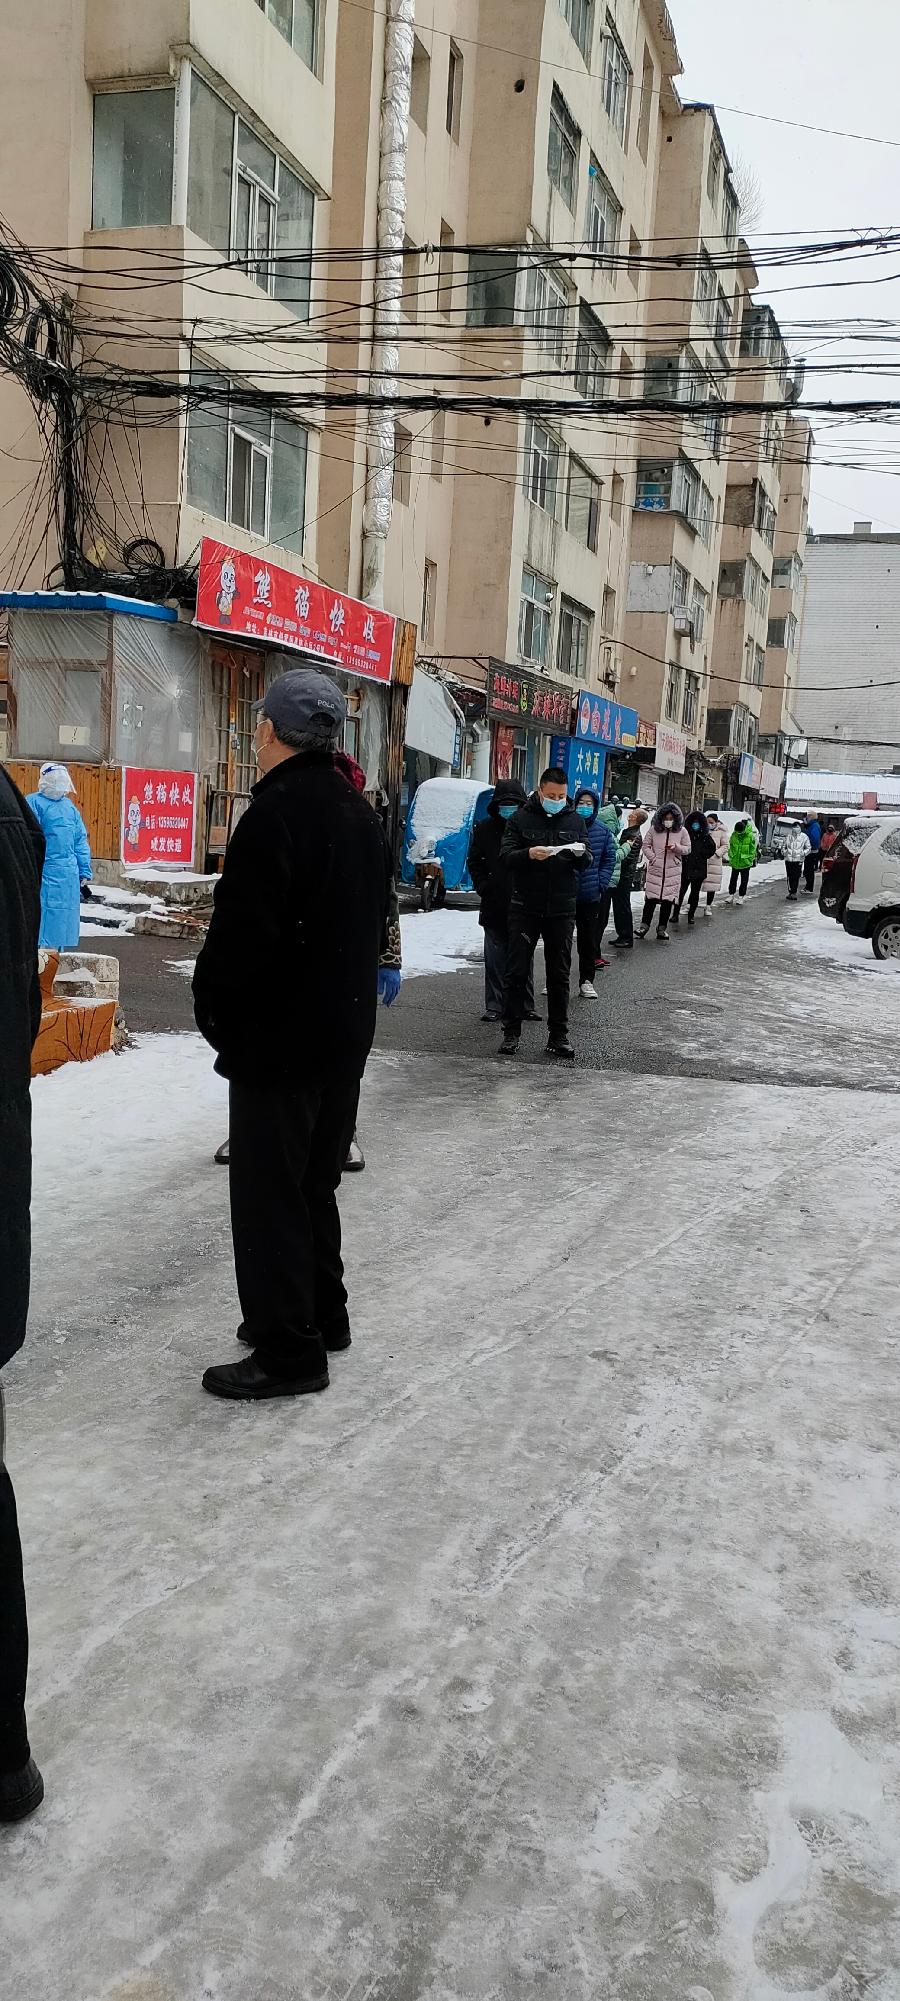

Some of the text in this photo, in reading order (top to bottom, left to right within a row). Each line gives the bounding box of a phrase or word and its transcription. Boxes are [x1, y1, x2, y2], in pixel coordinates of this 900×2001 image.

[252, 566, 376, 644] 熊猫快收
[317, 699, 335, 709] POLO
[576, 747, 601, 776] 大冷面
[142, 779, 193, 807] 熊猫快收
